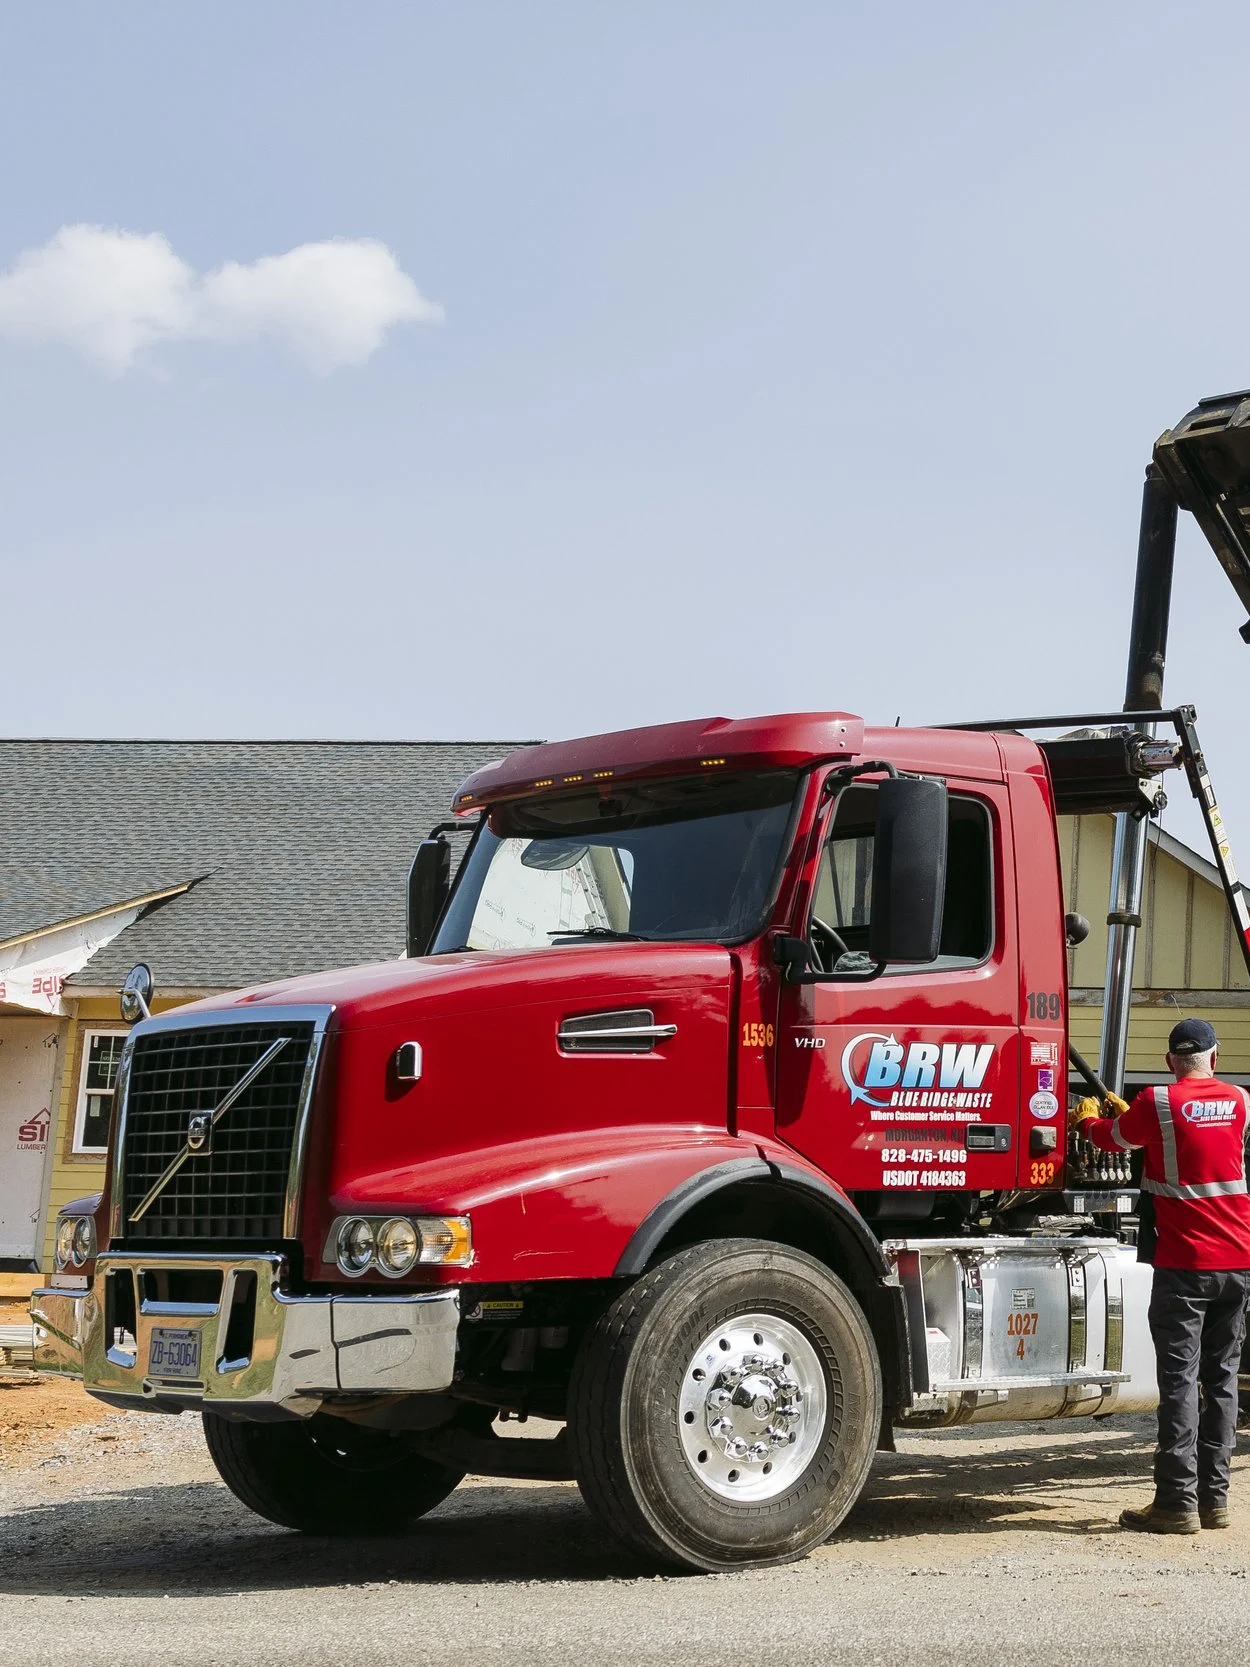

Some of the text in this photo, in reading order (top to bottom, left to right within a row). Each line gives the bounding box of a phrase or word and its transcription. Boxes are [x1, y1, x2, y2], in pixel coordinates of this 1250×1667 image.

[1027, 992, 1060, 1021] 189
[743, 1023, 774, 1047] 1536
[794, 1037, 826, 1048] VHD
[863, 1042, 996, 1088] BRW
[890, 1091, 993, 1108] BLUE RIDGE WASTE
[1191, 1100, 1237, 1116] BRW
[870, 1110, 982, 1121] Where Customer Service Matters.
[19, 1124, 50, 1141] SI
[951, 1128, 964, 1142] NC
[881, 1149, 967, 1164] 828-475-1496
[883, 1170, 966, 1186] USDOT 4184363
[1030, 1162, 1055, 1185] 333
[1007, 1312, 1039, 1336] 1027
[151, 1341, 198, 1367] ZB-63064
[1016, 1338, 1025, 1360] 4
